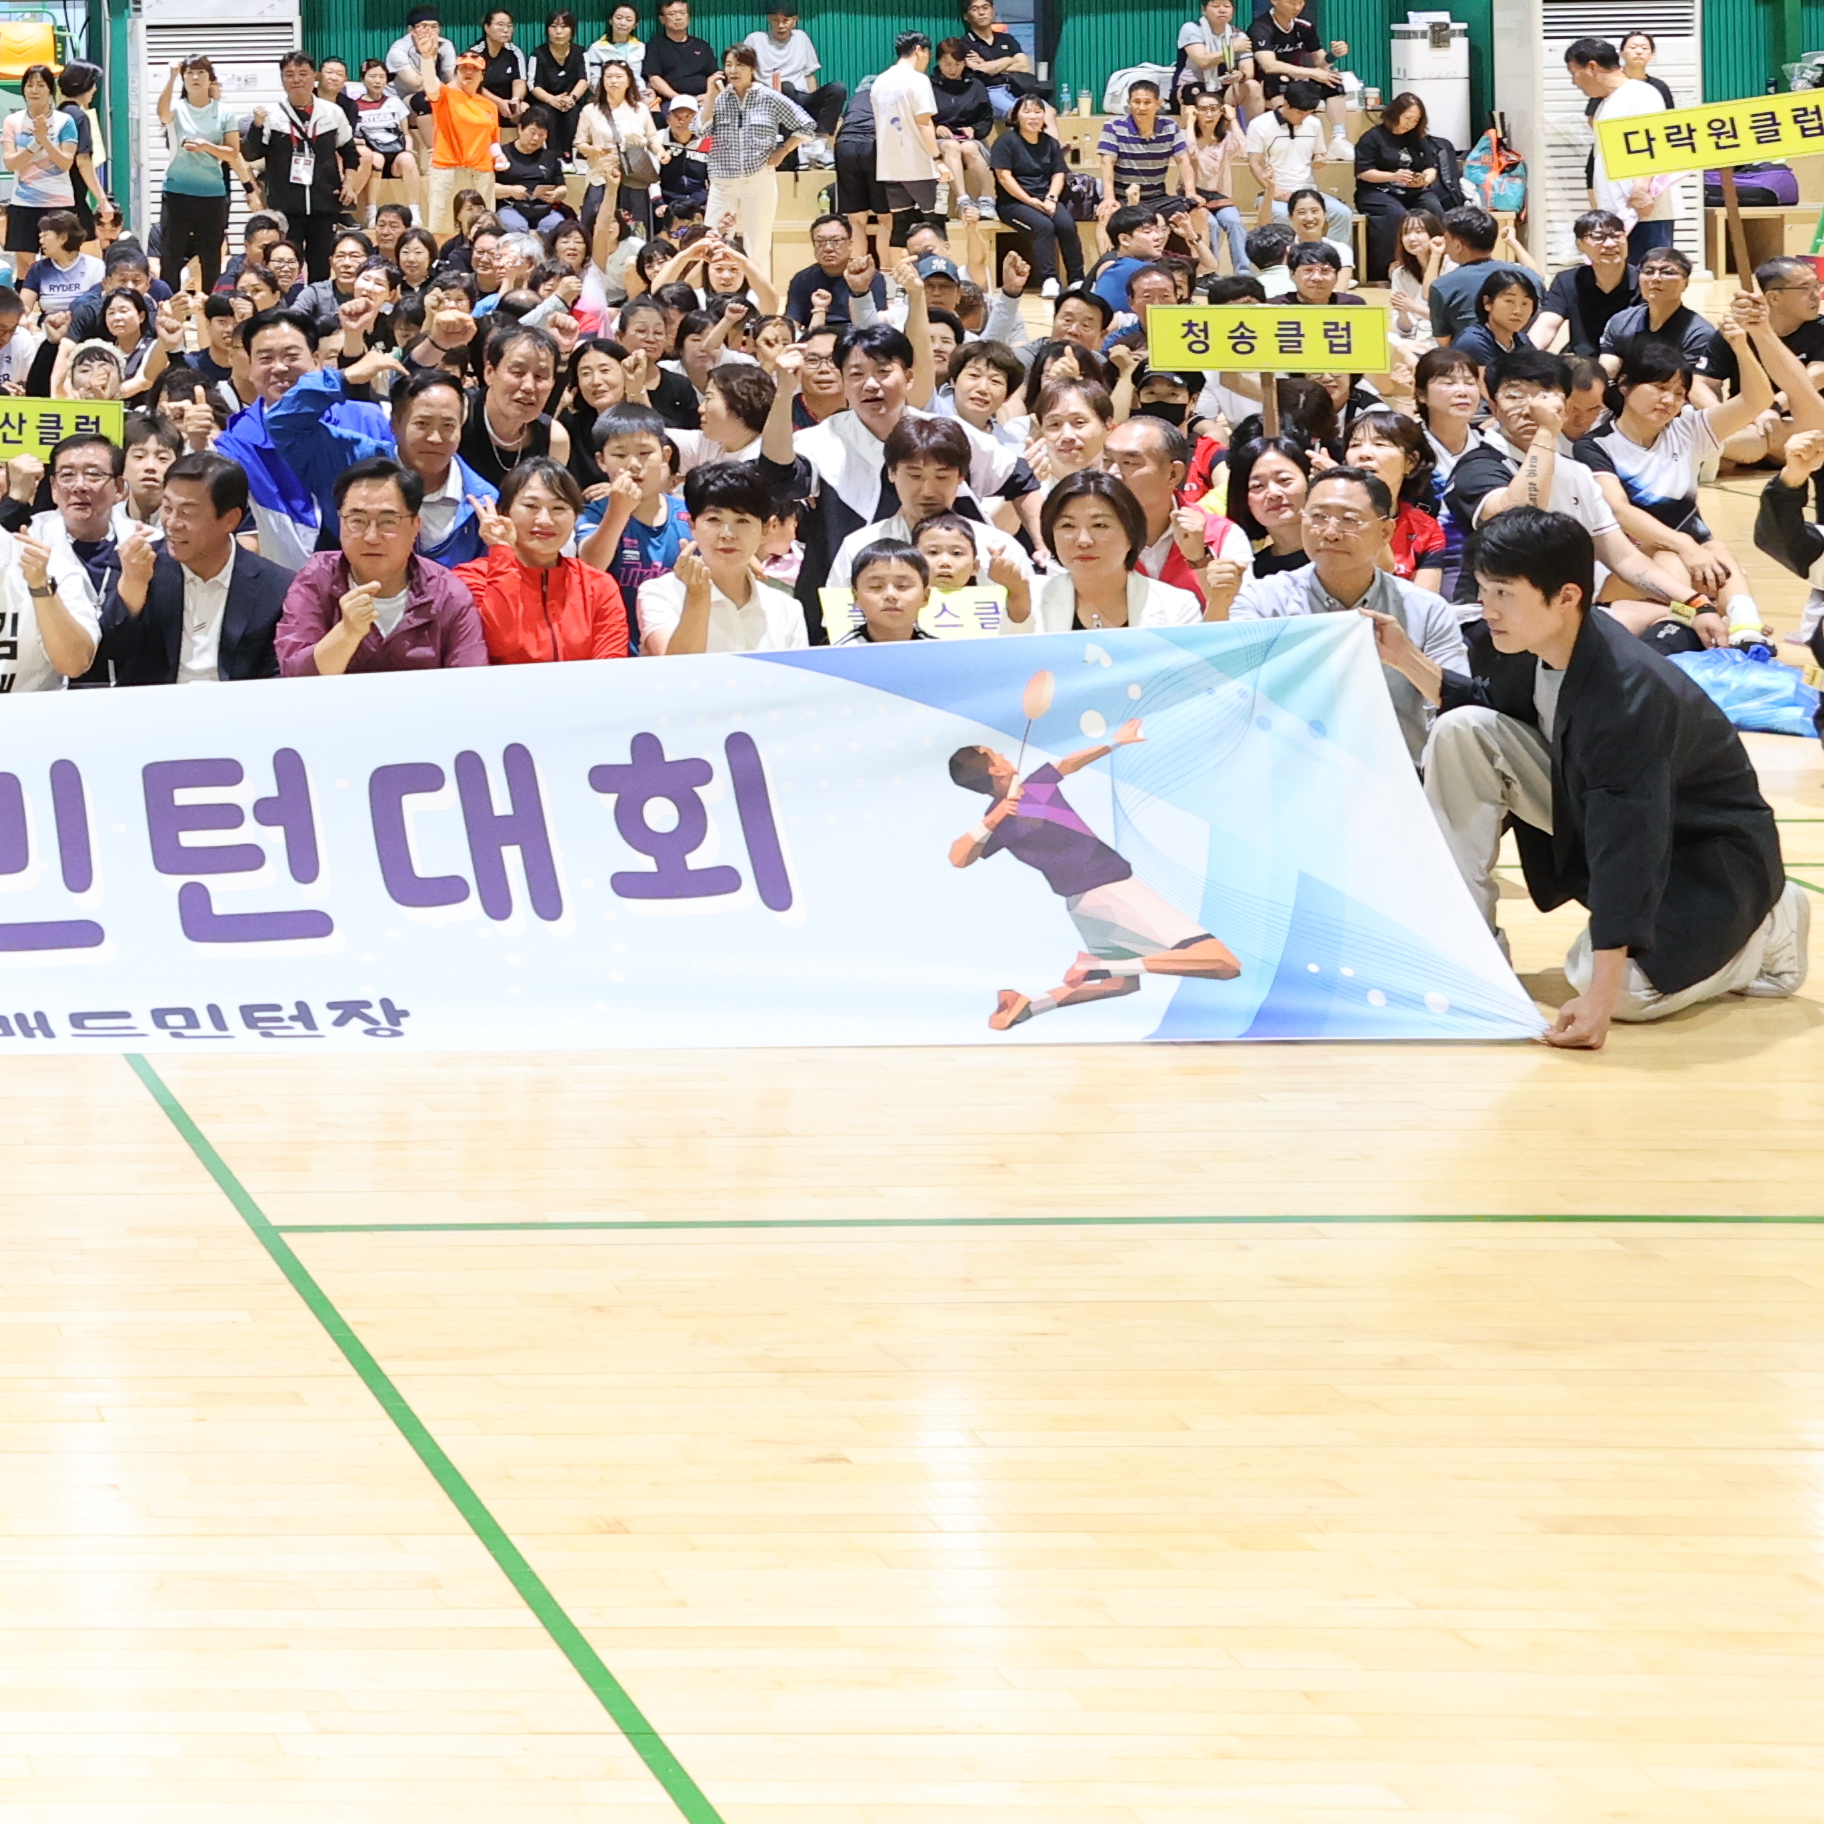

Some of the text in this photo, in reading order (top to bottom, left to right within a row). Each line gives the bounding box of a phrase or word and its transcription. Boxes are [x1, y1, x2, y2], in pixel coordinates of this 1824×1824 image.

[1624, 104, 1824, 160] 다락원클럽
[48, 283, 81, 293] RYDER
[1180, 319, 1352, 355] 청송클럽
